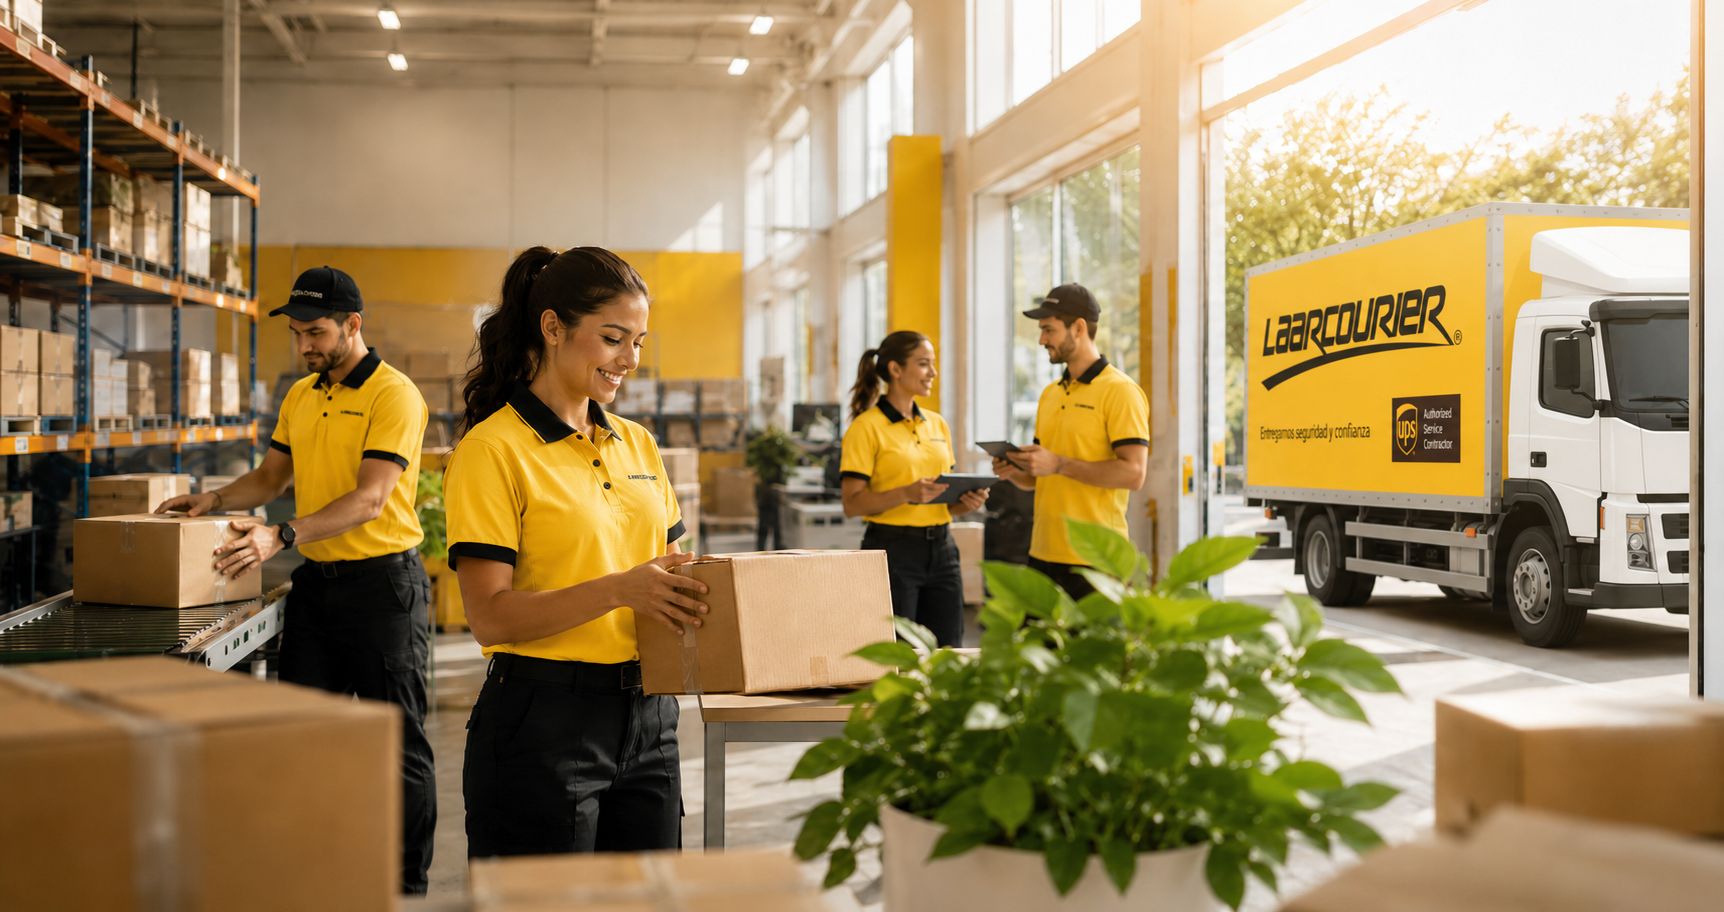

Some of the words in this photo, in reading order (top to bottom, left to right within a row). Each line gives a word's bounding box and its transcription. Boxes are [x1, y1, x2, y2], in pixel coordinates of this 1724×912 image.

[1260, 426, 1295, 443] Entregamos
[1295, 423, 1328, 443] seguridad
[1329, 427, 1333, 443] y
[1334, 422, 1371, 439] confianza
